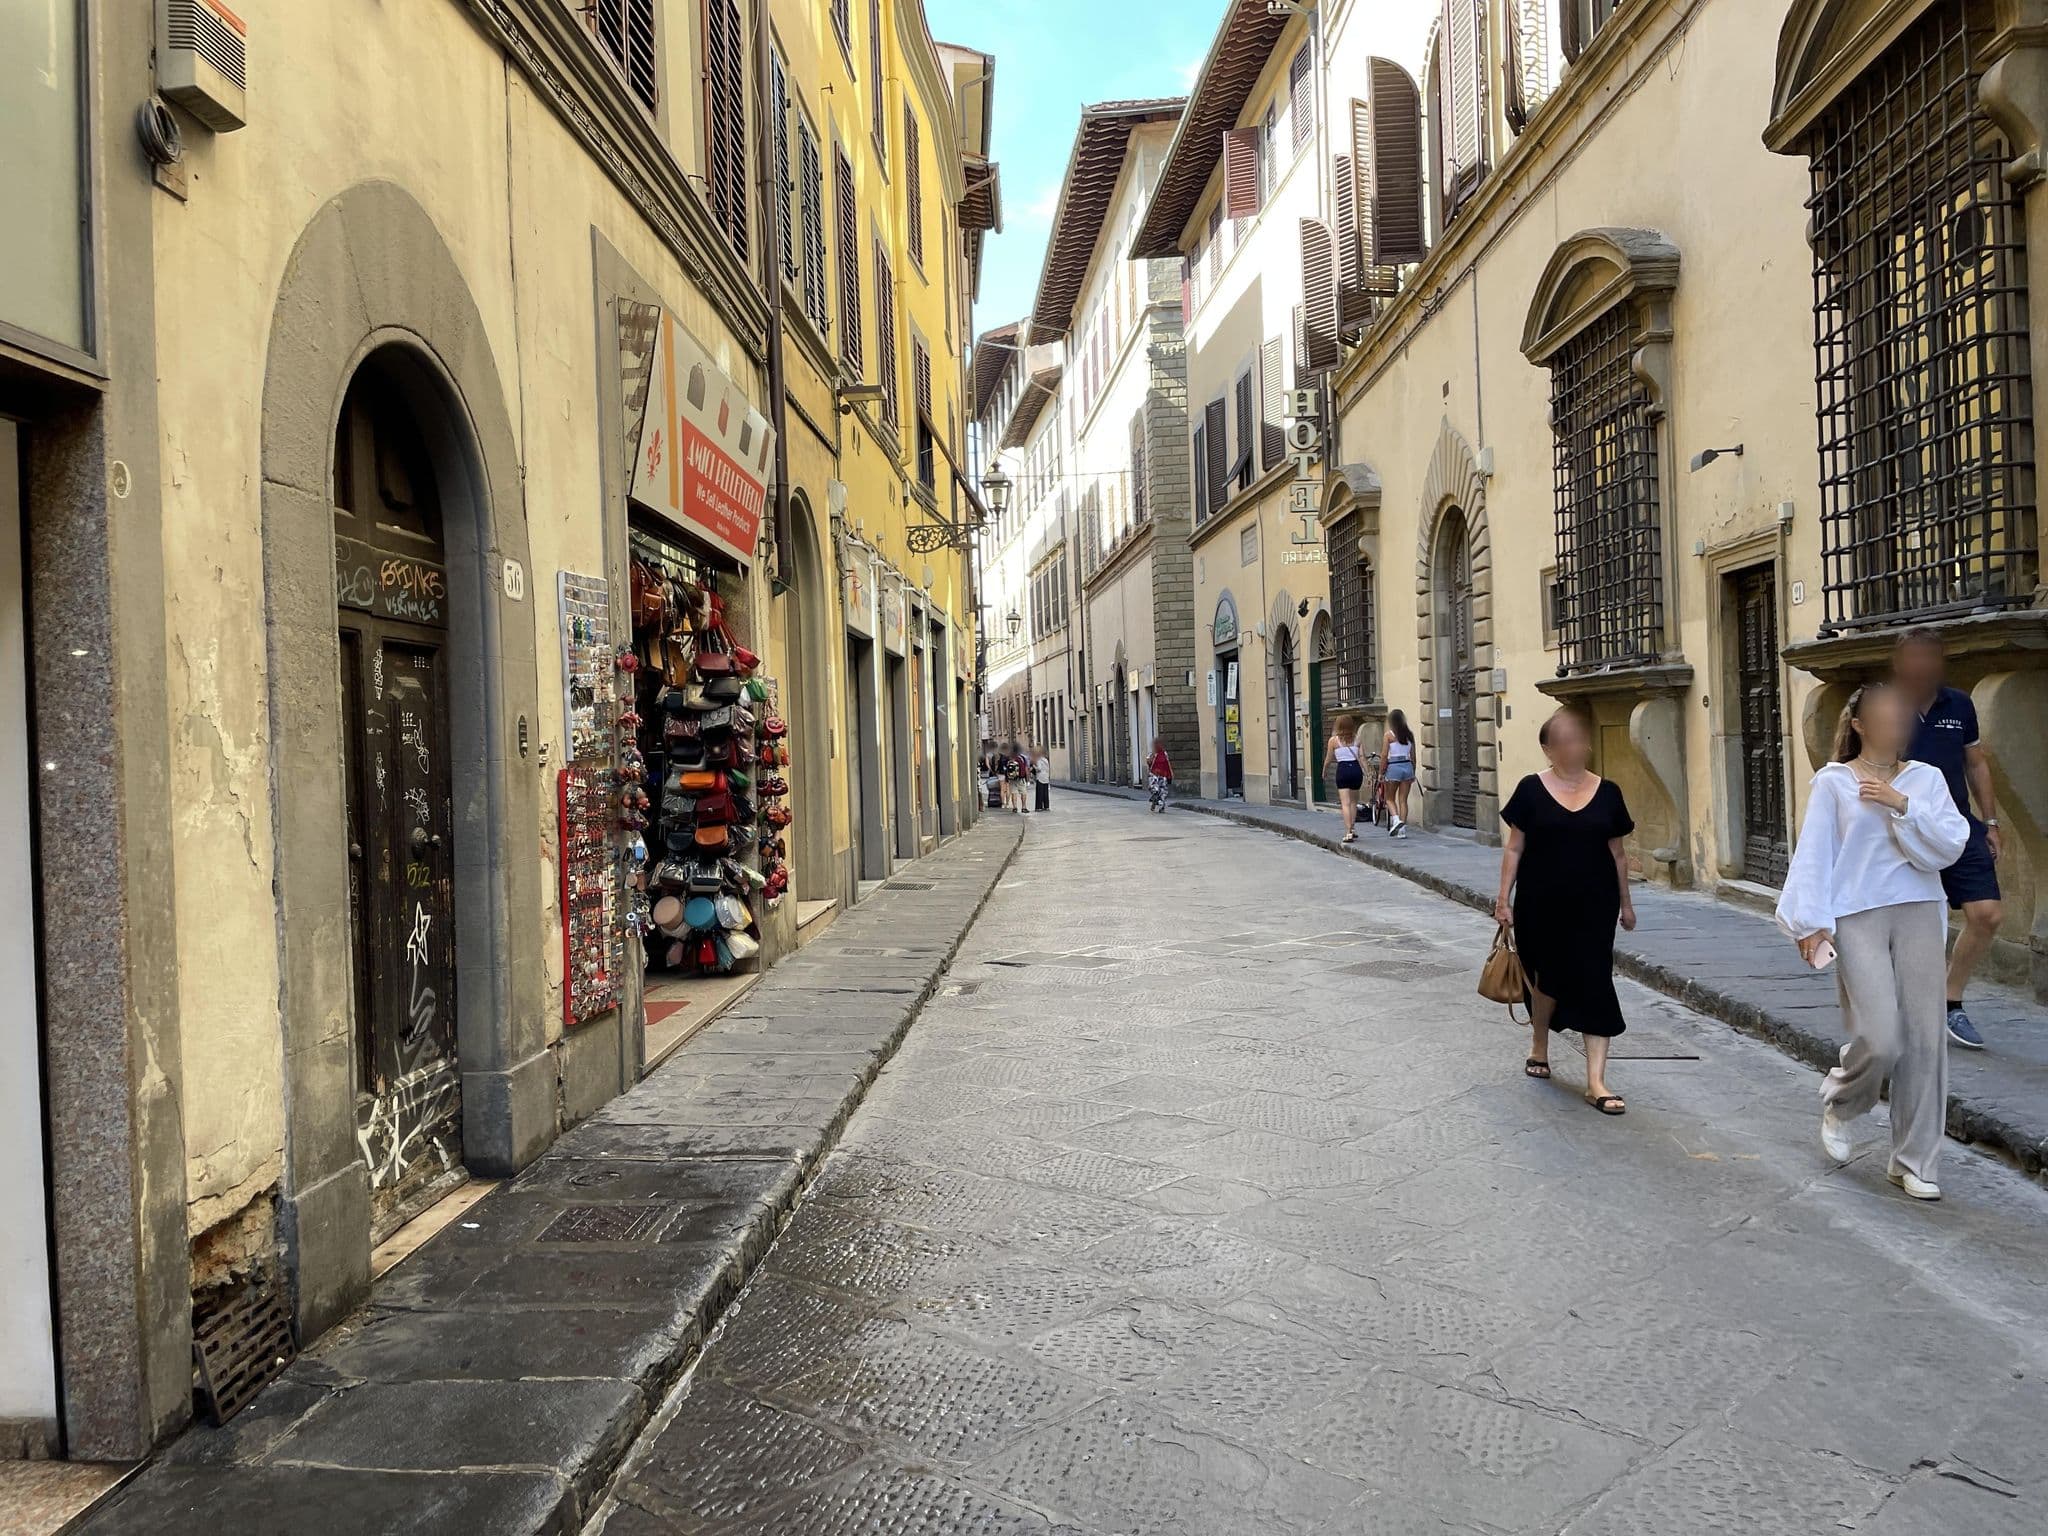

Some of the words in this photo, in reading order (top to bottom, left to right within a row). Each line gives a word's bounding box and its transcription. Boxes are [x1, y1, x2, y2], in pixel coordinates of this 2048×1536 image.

[686, 435, 716, 481] AMICI
[715, 458, 762, 518] PELLETTERIA
[696, 482, 706, 501] We
[705, 489, 716, 510] Sell
[715, 497, 733, 520] Leather
[732, 510, 751, 535] Products
